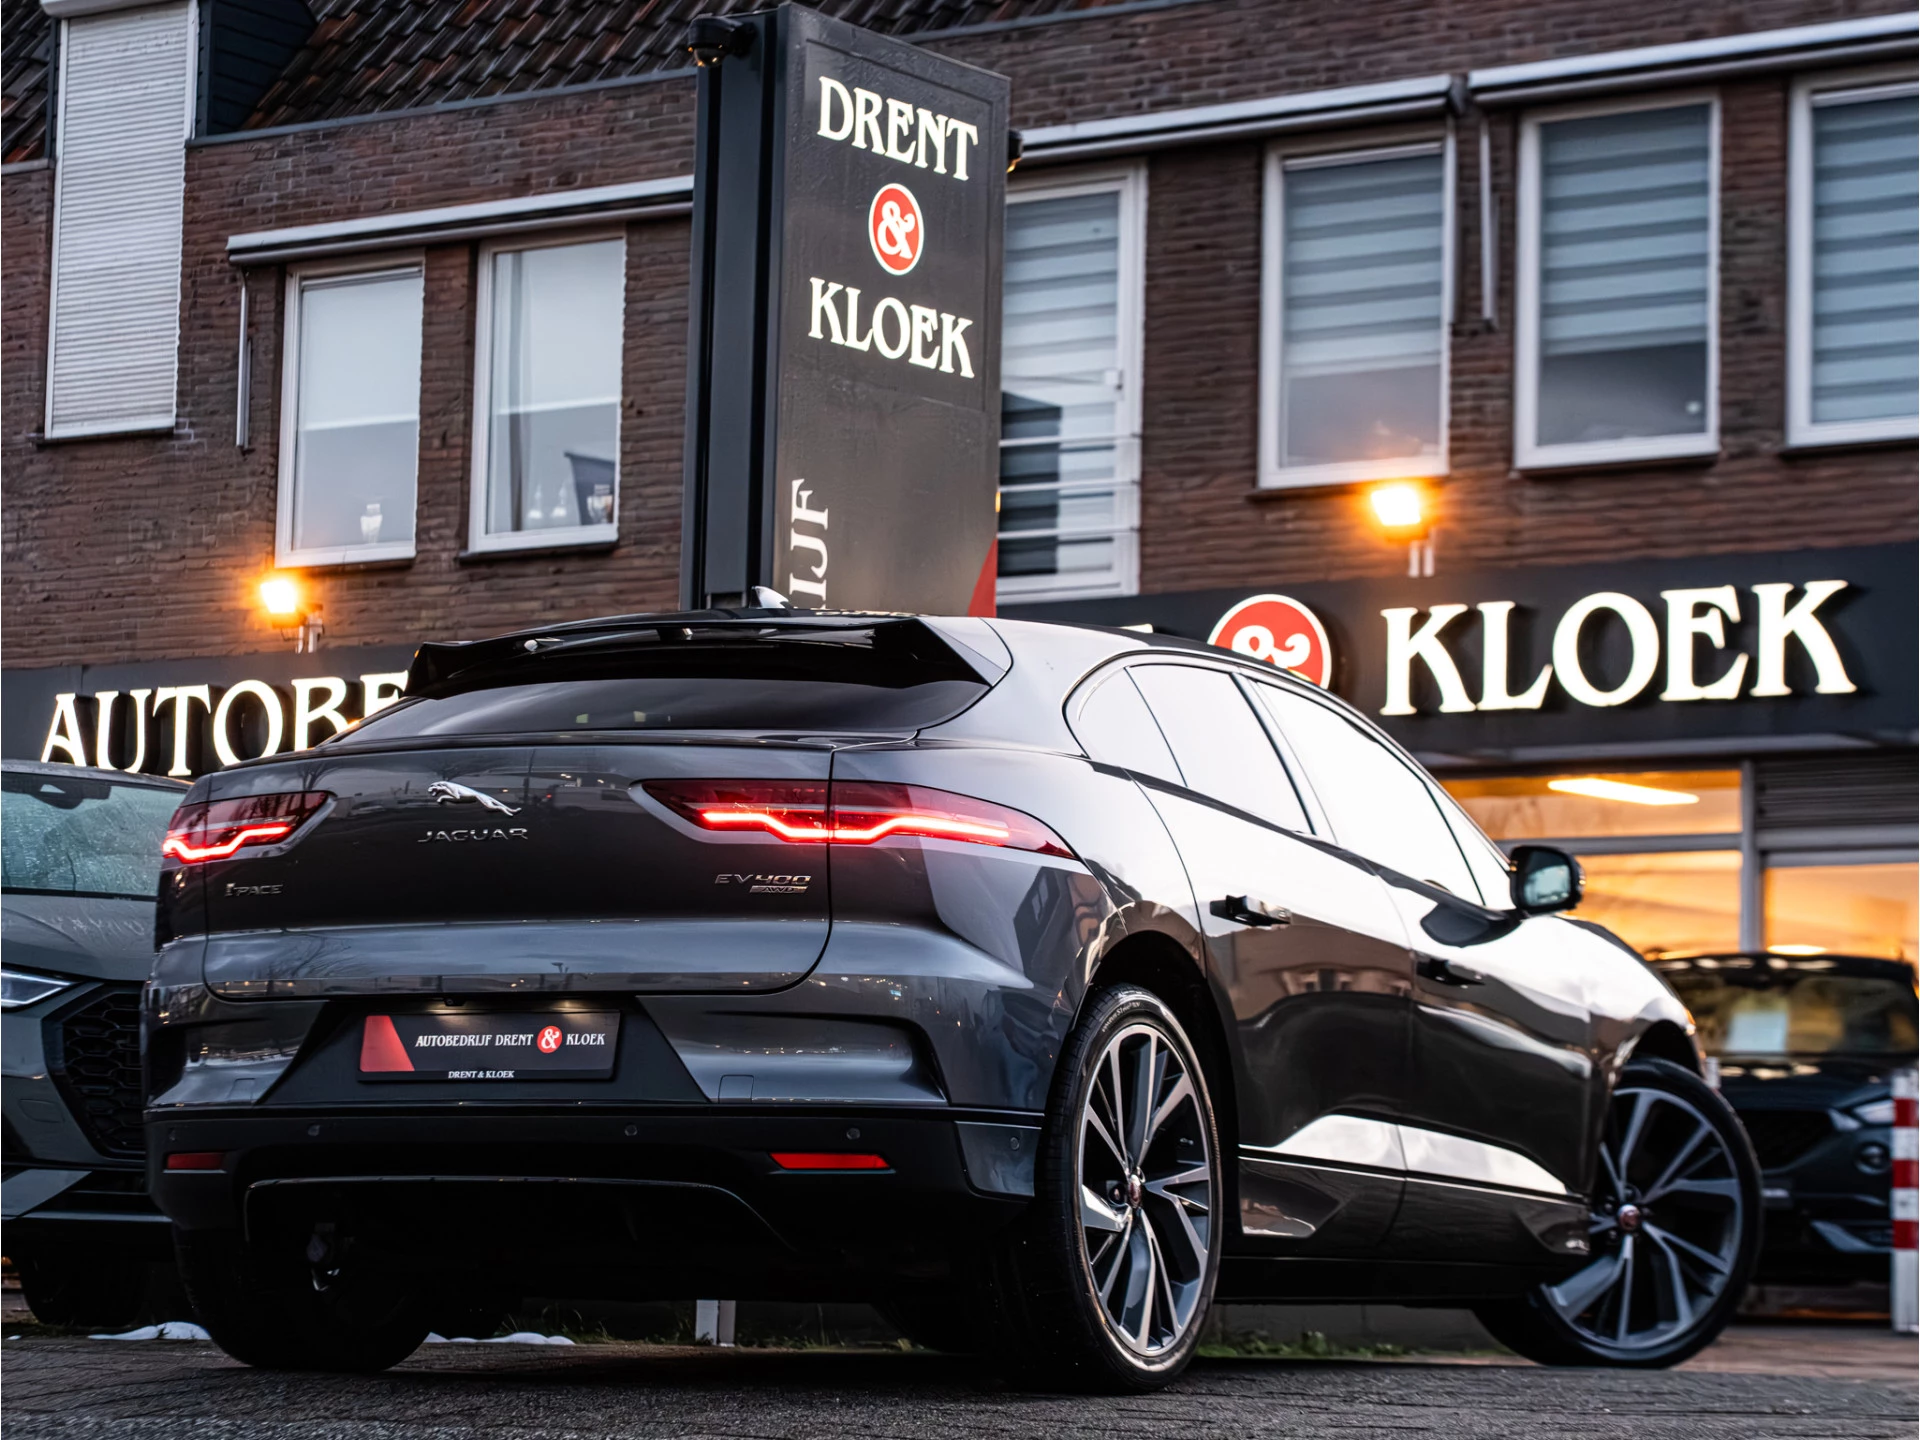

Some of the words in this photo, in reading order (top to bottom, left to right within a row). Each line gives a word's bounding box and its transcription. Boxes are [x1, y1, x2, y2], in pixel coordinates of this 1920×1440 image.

[817, 76, 978, 181] DRENT
[877, 200, 916, 260] &
[808, 277, 975, 379] KLOEK
[1380, 579, 1858, 716] KLOEK
[417, 828, 528, 843] JAGUAR
[715, 874, 811, 885] EV400
[415, 1034, 492, 1047] AUTOBEDRIJF
[495, 1034, 534, 1046] DRENT
[541, 1029, 560, 1049] &
[565, 1033, 606, 1046] KLOEK
[448, 1070, 477, 1079] DRENT
[477, 1070, 484, 1079] &
[485, 1070, 515, 1079] KLOEK
